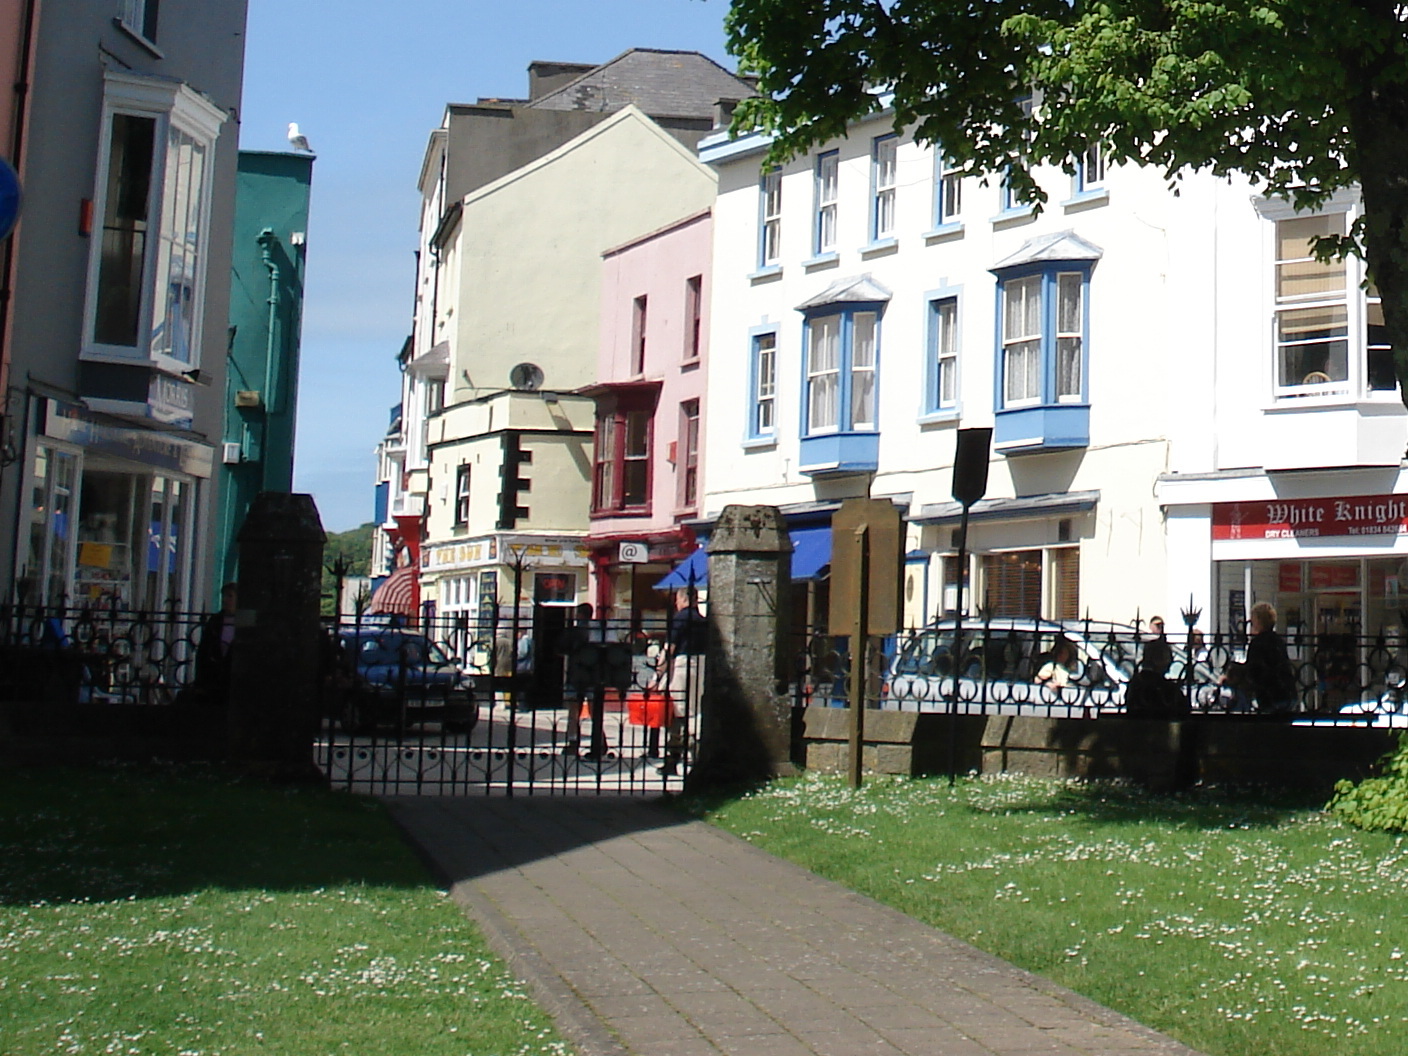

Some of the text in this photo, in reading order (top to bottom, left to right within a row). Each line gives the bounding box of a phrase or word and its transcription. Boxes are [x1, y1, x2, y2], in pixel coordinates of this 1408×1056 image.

[1267, 500, 1407, 526] White Knight
[1265, 527, 1320, 538] DRY CLEANERS
